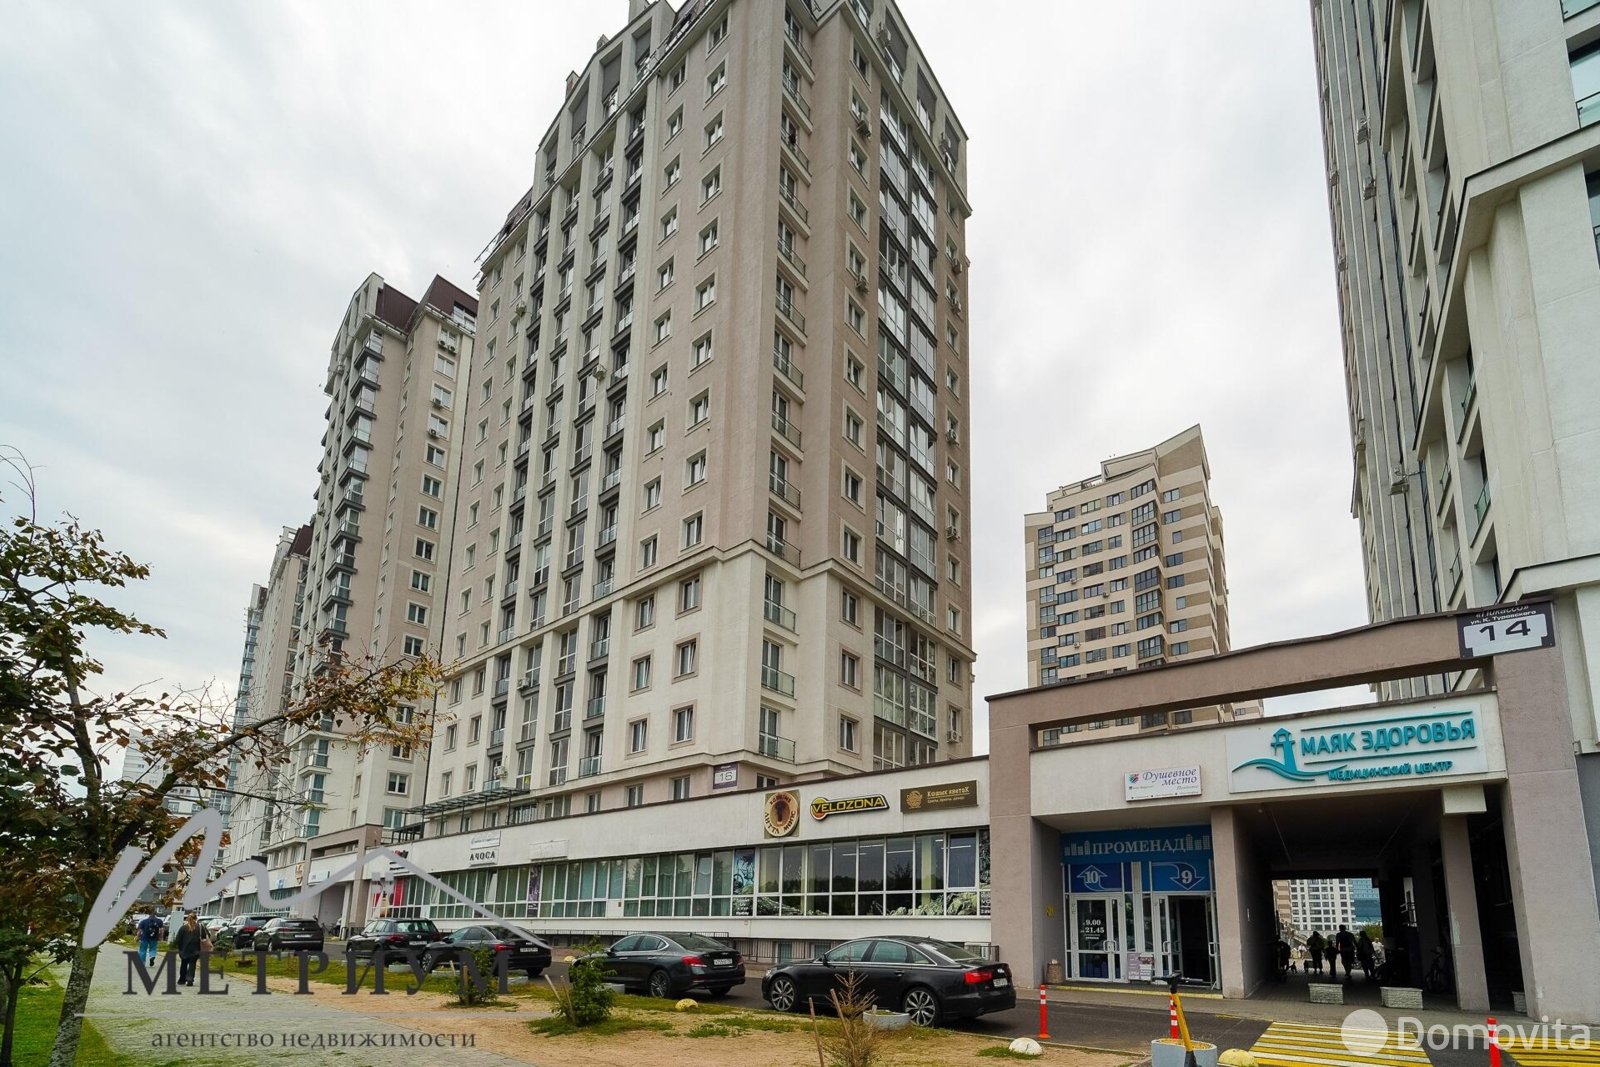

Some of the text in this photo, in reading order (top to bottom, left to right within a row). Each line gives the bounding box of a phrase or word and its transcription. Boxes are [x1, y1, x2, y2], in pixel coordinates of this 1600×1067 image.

[1492, 610, 1537, 621] Туровского
[1479, 619, 1531, 641] 14
[1301, 718, 1476, 756] МАЯК ЗДОРОВЬЯ
[719, 771, 733, 781] 16
[1142, 768, 1197, 783] Душевное
[1328, 761, 1453, 781] МЕДИЦИНСКИЙ ЦЕНТР
[1161, 776, 1197, 786] место
[812, 797, 884, 812] VELOZONA
[1092, 838, 1186, 855] ПРОМЕНАД
[1085, 871, 1099, 884] 10
[1181, 870, 1192, 884] 9
